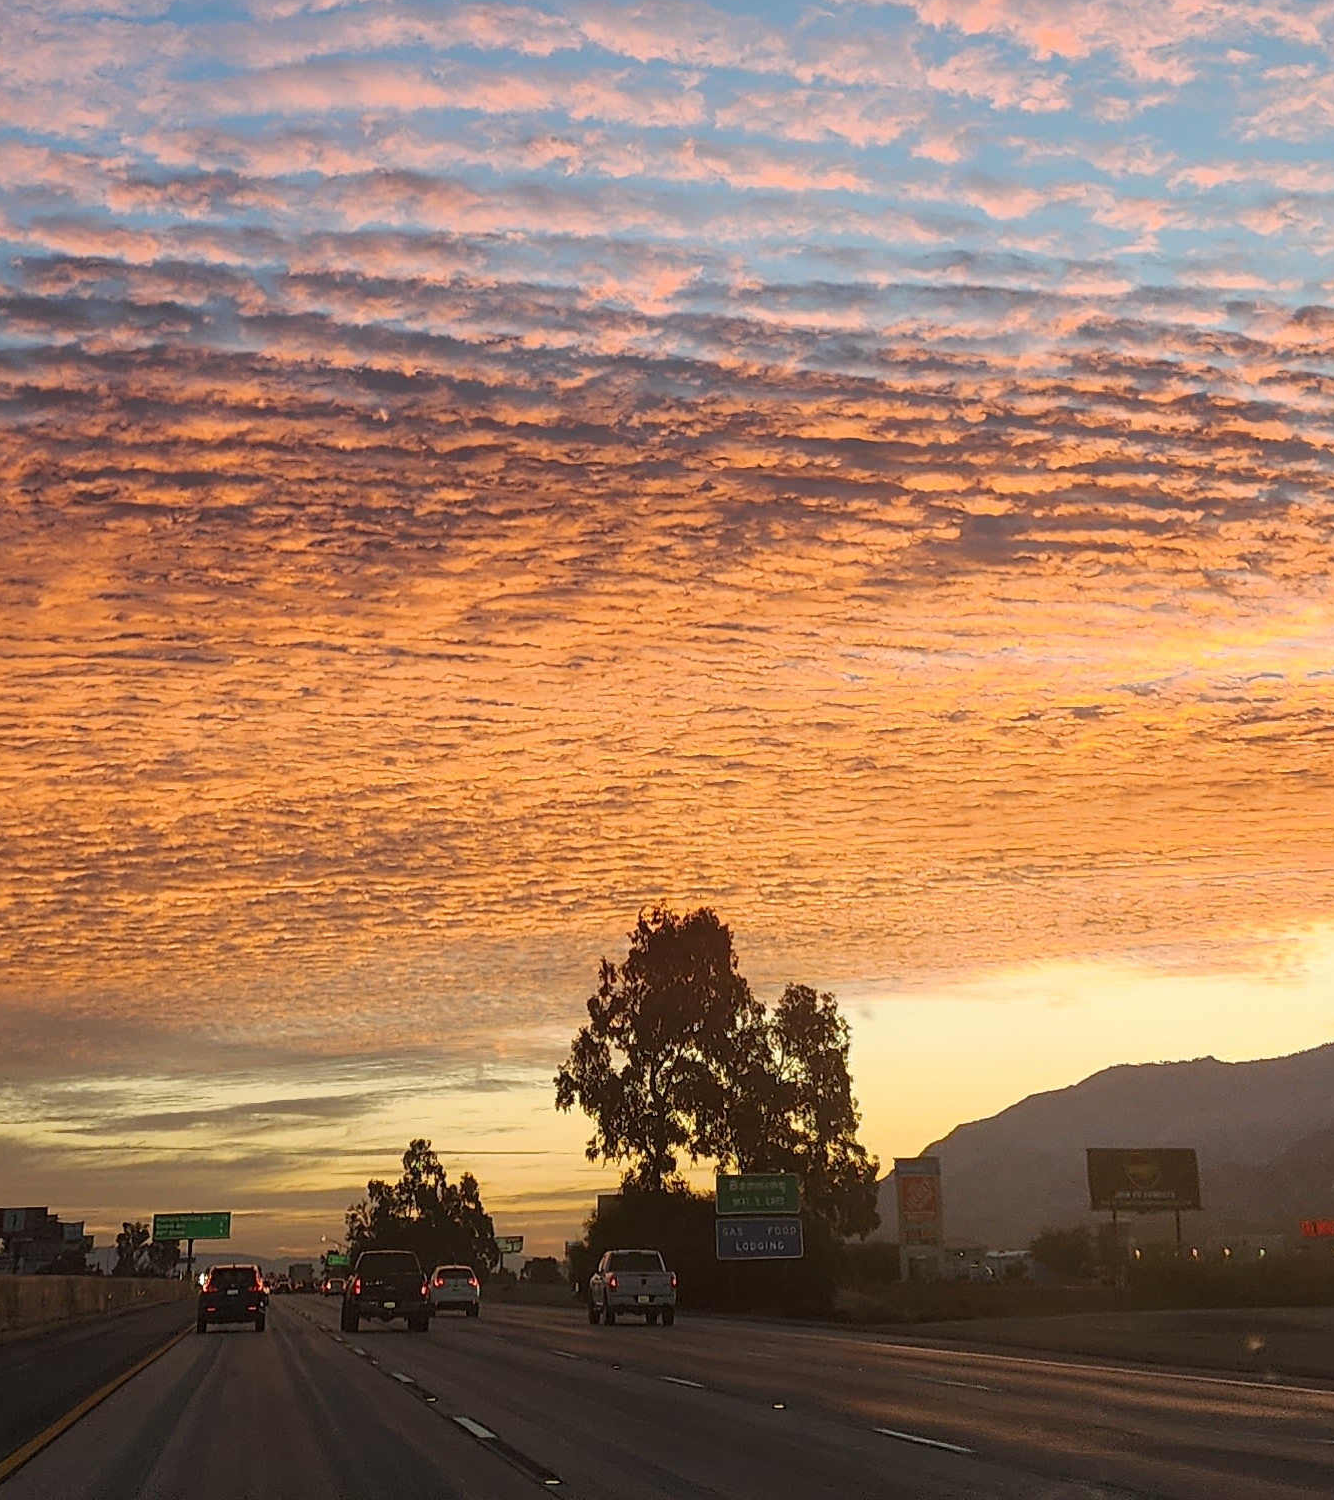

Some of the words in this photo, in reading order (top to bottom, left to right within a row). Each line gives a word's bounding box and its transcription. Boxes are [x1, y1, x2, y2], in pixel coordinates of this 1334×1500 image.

[722, 1227, 744, 1236] GAS
[767, 1226, 797, 1236] FOOD
[736, 1241, 785, 1251] LODGING
